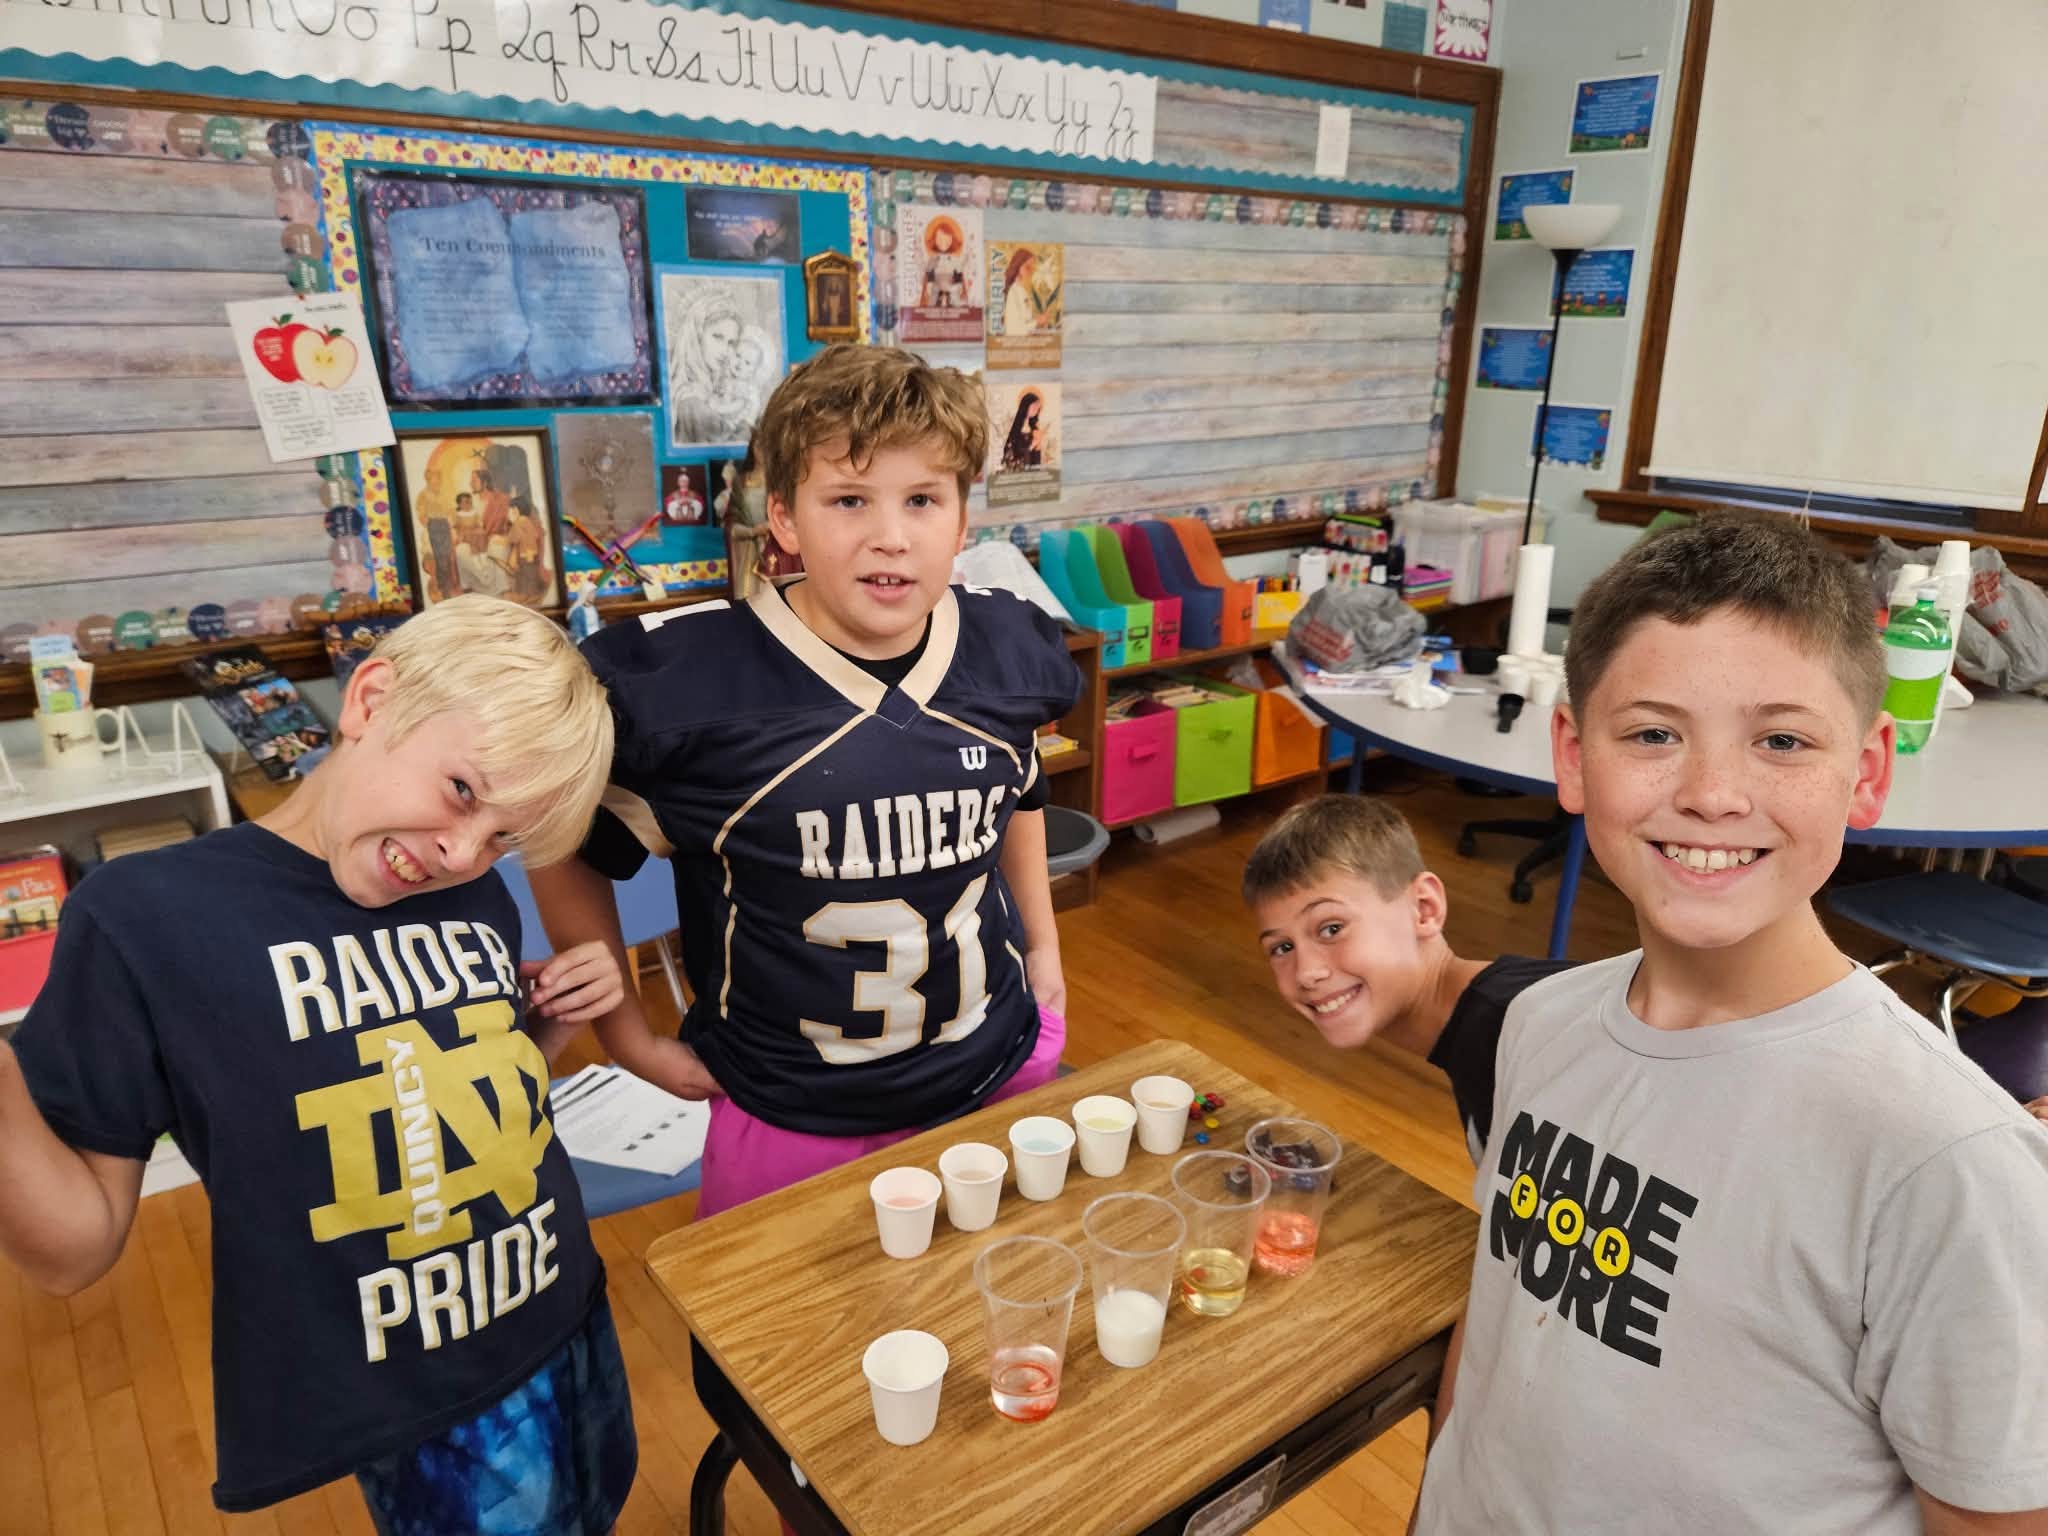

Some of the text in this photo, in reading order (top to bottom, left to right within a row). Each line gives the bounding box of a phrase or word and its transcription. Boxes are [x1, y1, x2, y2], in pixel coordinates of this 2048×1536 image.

[419, 236, 606, 258] Ten Commandments
[796, 785, 1006, 880] RAIDERS
[268, 919, 525, 1043] RAIDER
[799, 872, 993, 1065] 31
[384, 1037, 444, 1236] QUINCY
[1498, 1110, 1700, 1276] MADE
[357, 1197, 560, 1364] PRIDE
[1489, 1189, 1671, 1369] MORE
[1515, 1181, 1623, 1269] FOR
